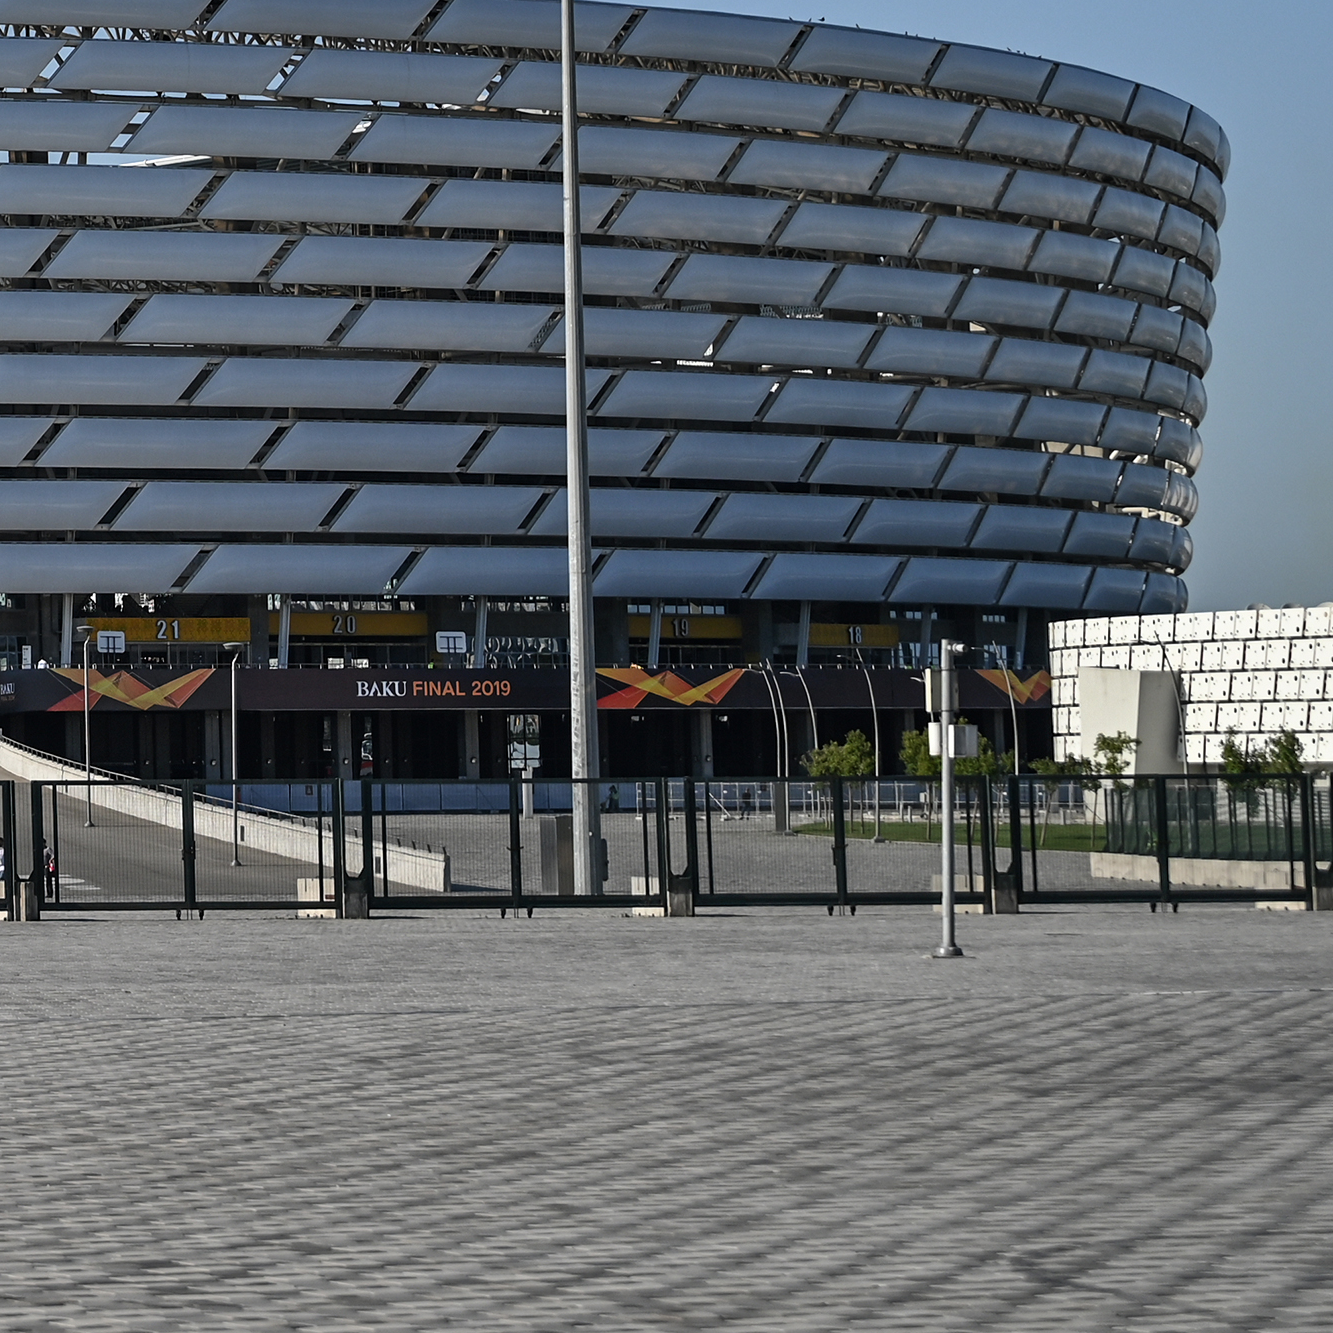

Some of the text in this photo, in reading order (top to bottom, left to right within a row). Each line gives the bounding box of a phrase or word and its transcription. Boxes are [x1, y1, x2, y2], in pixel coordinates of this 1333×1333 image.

[156, 619, 179, 640] 21
[333, 615, 356, 634] 20
[671, 618, 690, 637] 19
[848, 626, 862, 644] 18
[356, 680, 511, 697] BAKU FINAL 2019
